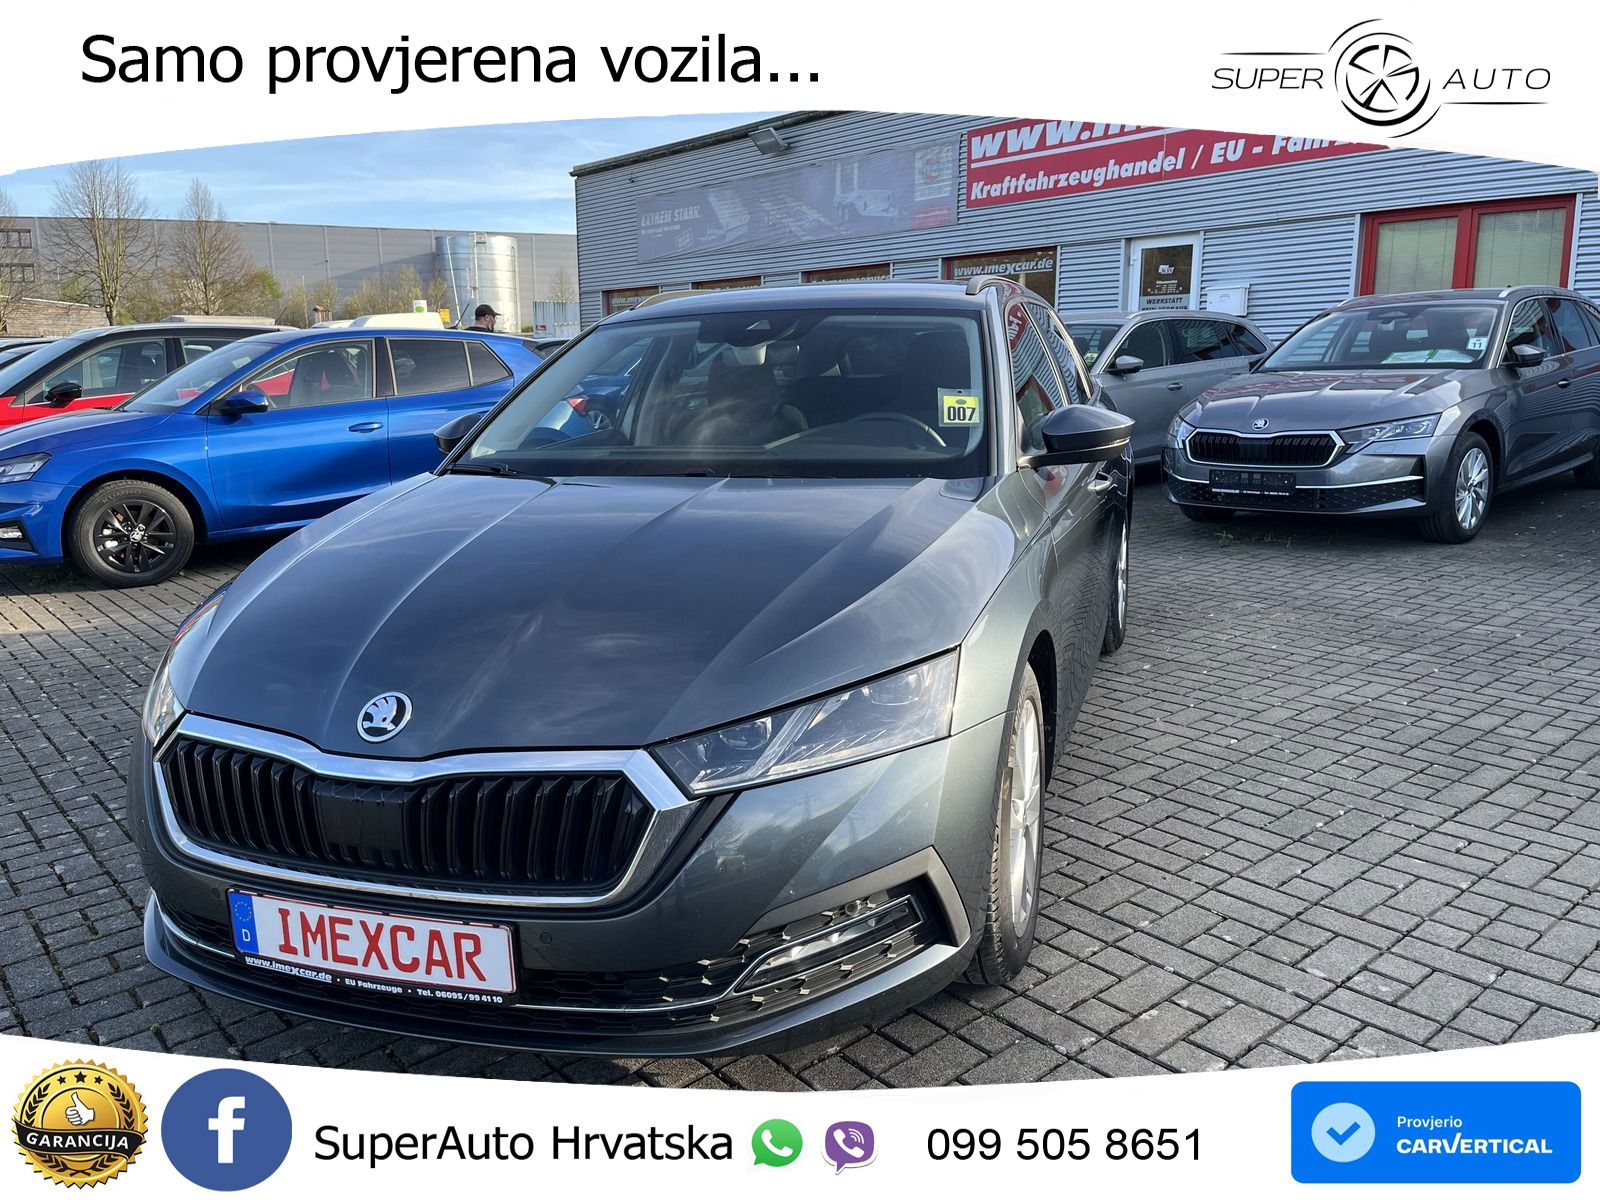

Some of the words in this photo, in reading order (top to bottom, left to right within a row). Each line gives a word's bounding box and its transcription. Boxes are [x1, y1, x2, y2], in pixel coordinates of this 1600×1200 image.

[971, 147, 1186, 200] Kraftfahrzeughandel
[1210, 138, 1246, 164] EU
[954, 257, 1053, 276] www.imexcar.de
[947, 406, 976, 421] 007
[242, 928, 251, 942] D
[278, 907, 487, 982] IMEXCAR
[245, 956, 332, 981] www.imexcar.de
[345, 978, 356, 986] EU
[358, 980, 403, 994] Fahrzeuge
[417, 988, 434, 997] Tel.
